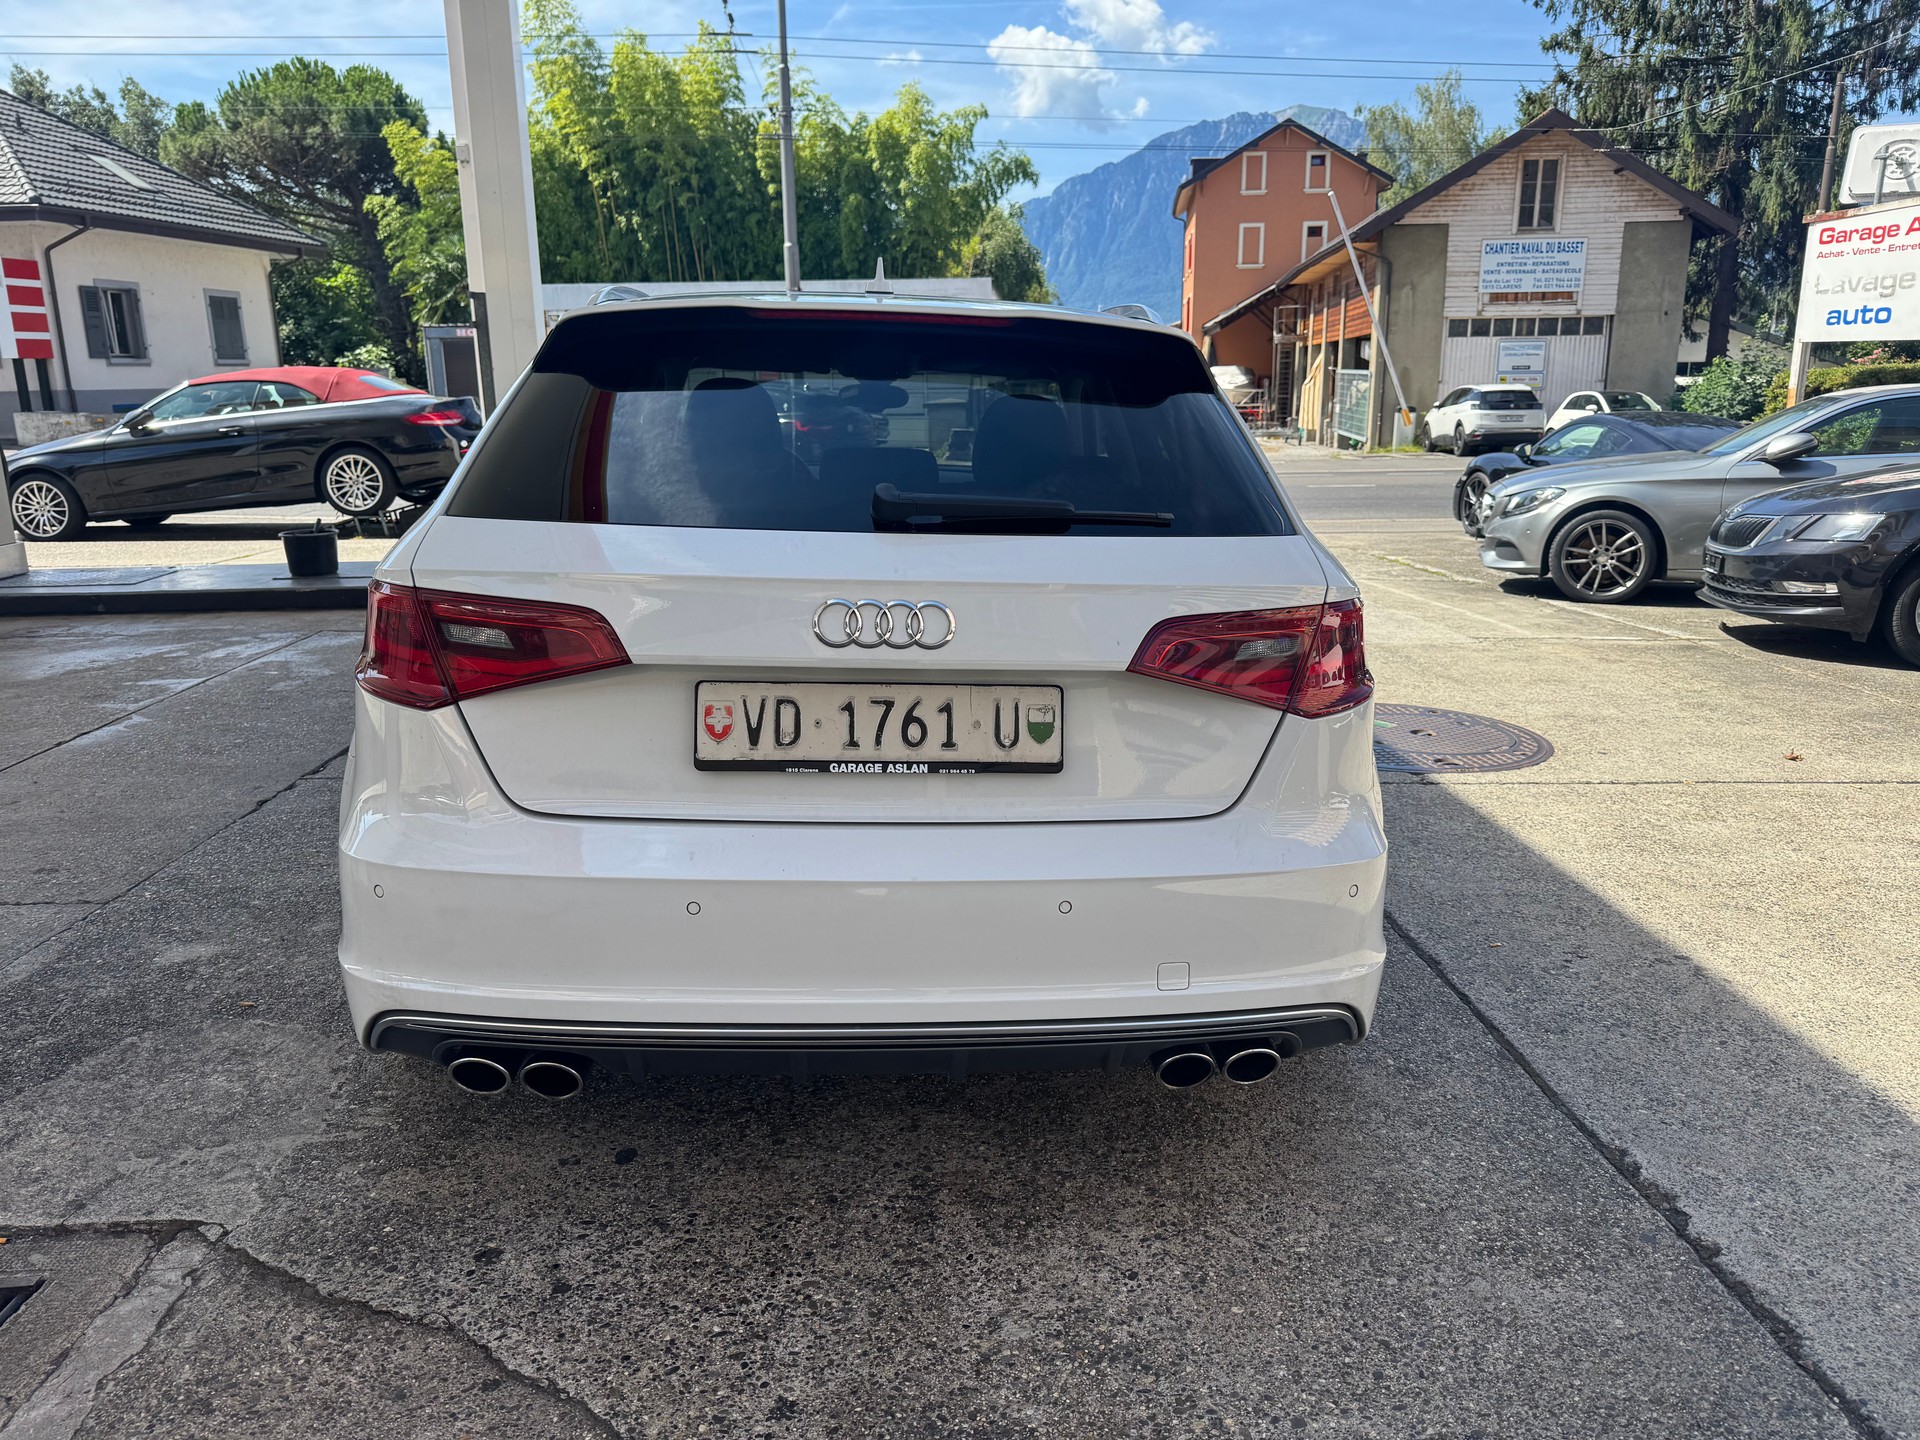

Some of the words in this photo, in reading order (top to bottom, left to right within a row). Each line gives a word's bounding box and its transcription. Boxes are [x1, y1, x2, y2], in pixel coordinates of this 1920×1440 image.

[1819, 224, 1901, 245] Garage
[1485, 242, 1520, 255] CHANTIER
[1521, 242, 1544, 254] NAVAL
[1545, 241, 1556, 253] DU
[1557, 241, 1584, 253] BASSET
[1816, 250, 1845, 259] Achat
[1852, 247, 1881, 255] Vente
[1815, 271, 1916, 298] Lavage
[1826, 304, 1893, 326] auto
[741, 696, 801, 749] VD
[840, 698, 958, 750] 1761
[994, 698, 1020, 749] U
[829, 763, 883, 773] GARAGE
[887, 763, 928, 774] ASLAN
